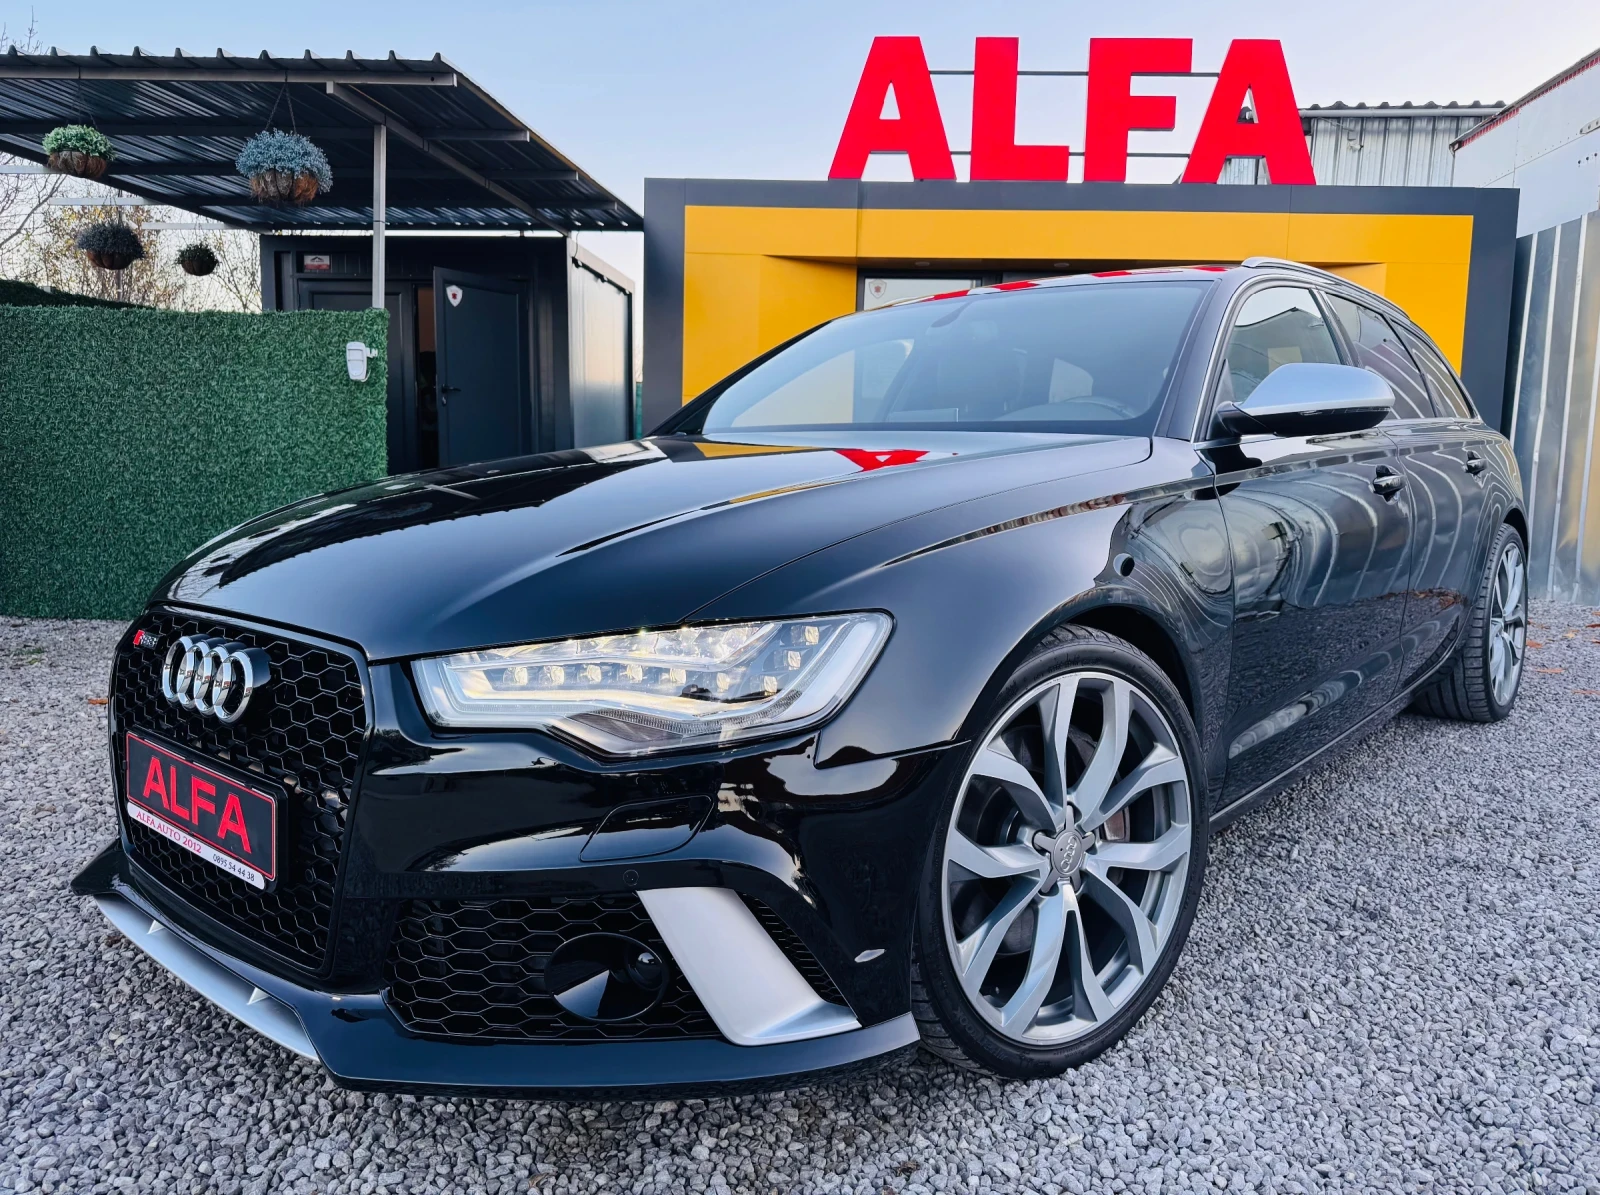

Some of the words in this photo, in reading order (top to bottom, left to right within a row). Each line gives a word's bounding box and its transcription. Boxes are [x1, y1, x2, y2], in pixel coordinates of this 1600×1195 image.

[828, 36, 1317, 185] ALFA
[136, 811, 156, 828] ALFA
[156, 822, 181, 841] AUTO
[182, 835, 202, 853] 2012
[143, 756, 252, 854] ALFA
[212, 853, 228, 867] 0895
[228, 861, 236, 872] 54
[237, 867, 246, 877] 44
[246, 871, 255, 882] 38
